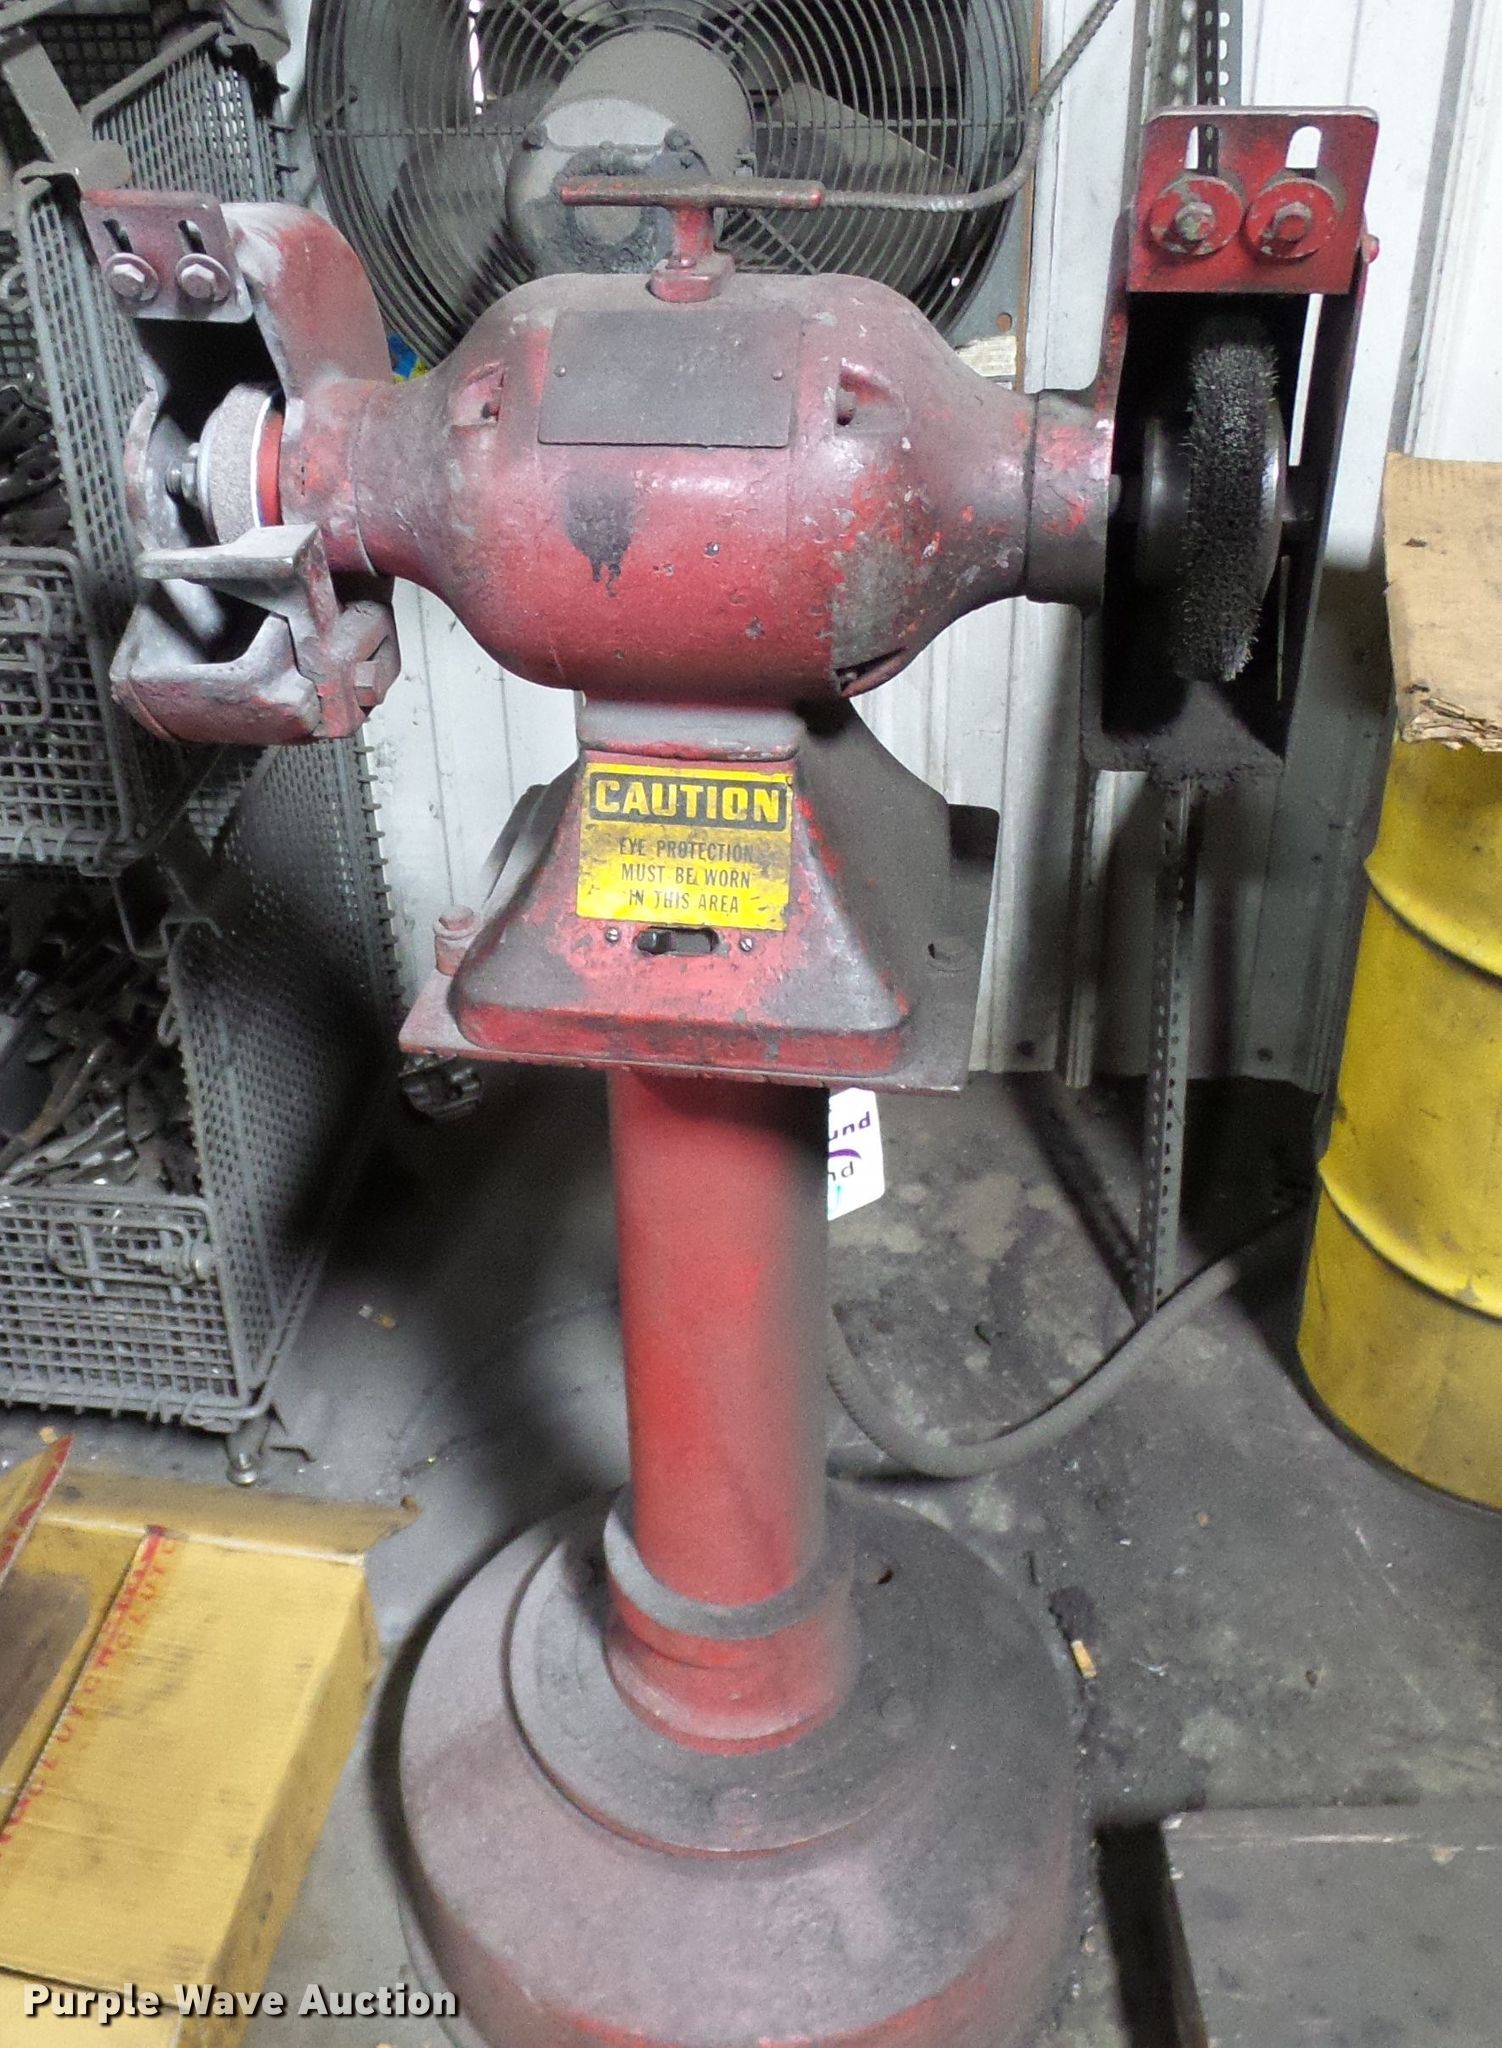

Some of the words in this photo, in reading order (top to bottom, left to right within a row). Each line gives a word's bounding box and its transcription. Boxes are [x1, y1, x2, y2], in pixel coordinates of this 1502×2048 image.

[595, 779, 780, 824] CAUTION
[619, 836, 647, 857] EYE
[656, 839, 755, 864] PROTECTION
[621, 863, 666, 883] MUST
[675, 866, 696, 886] BE
[705, 869, 751, 889] WORN
[629, 888, 645, 906] IN
[654, 890, 691, 910] THIS
[698, 894, 740, 913] AREA
